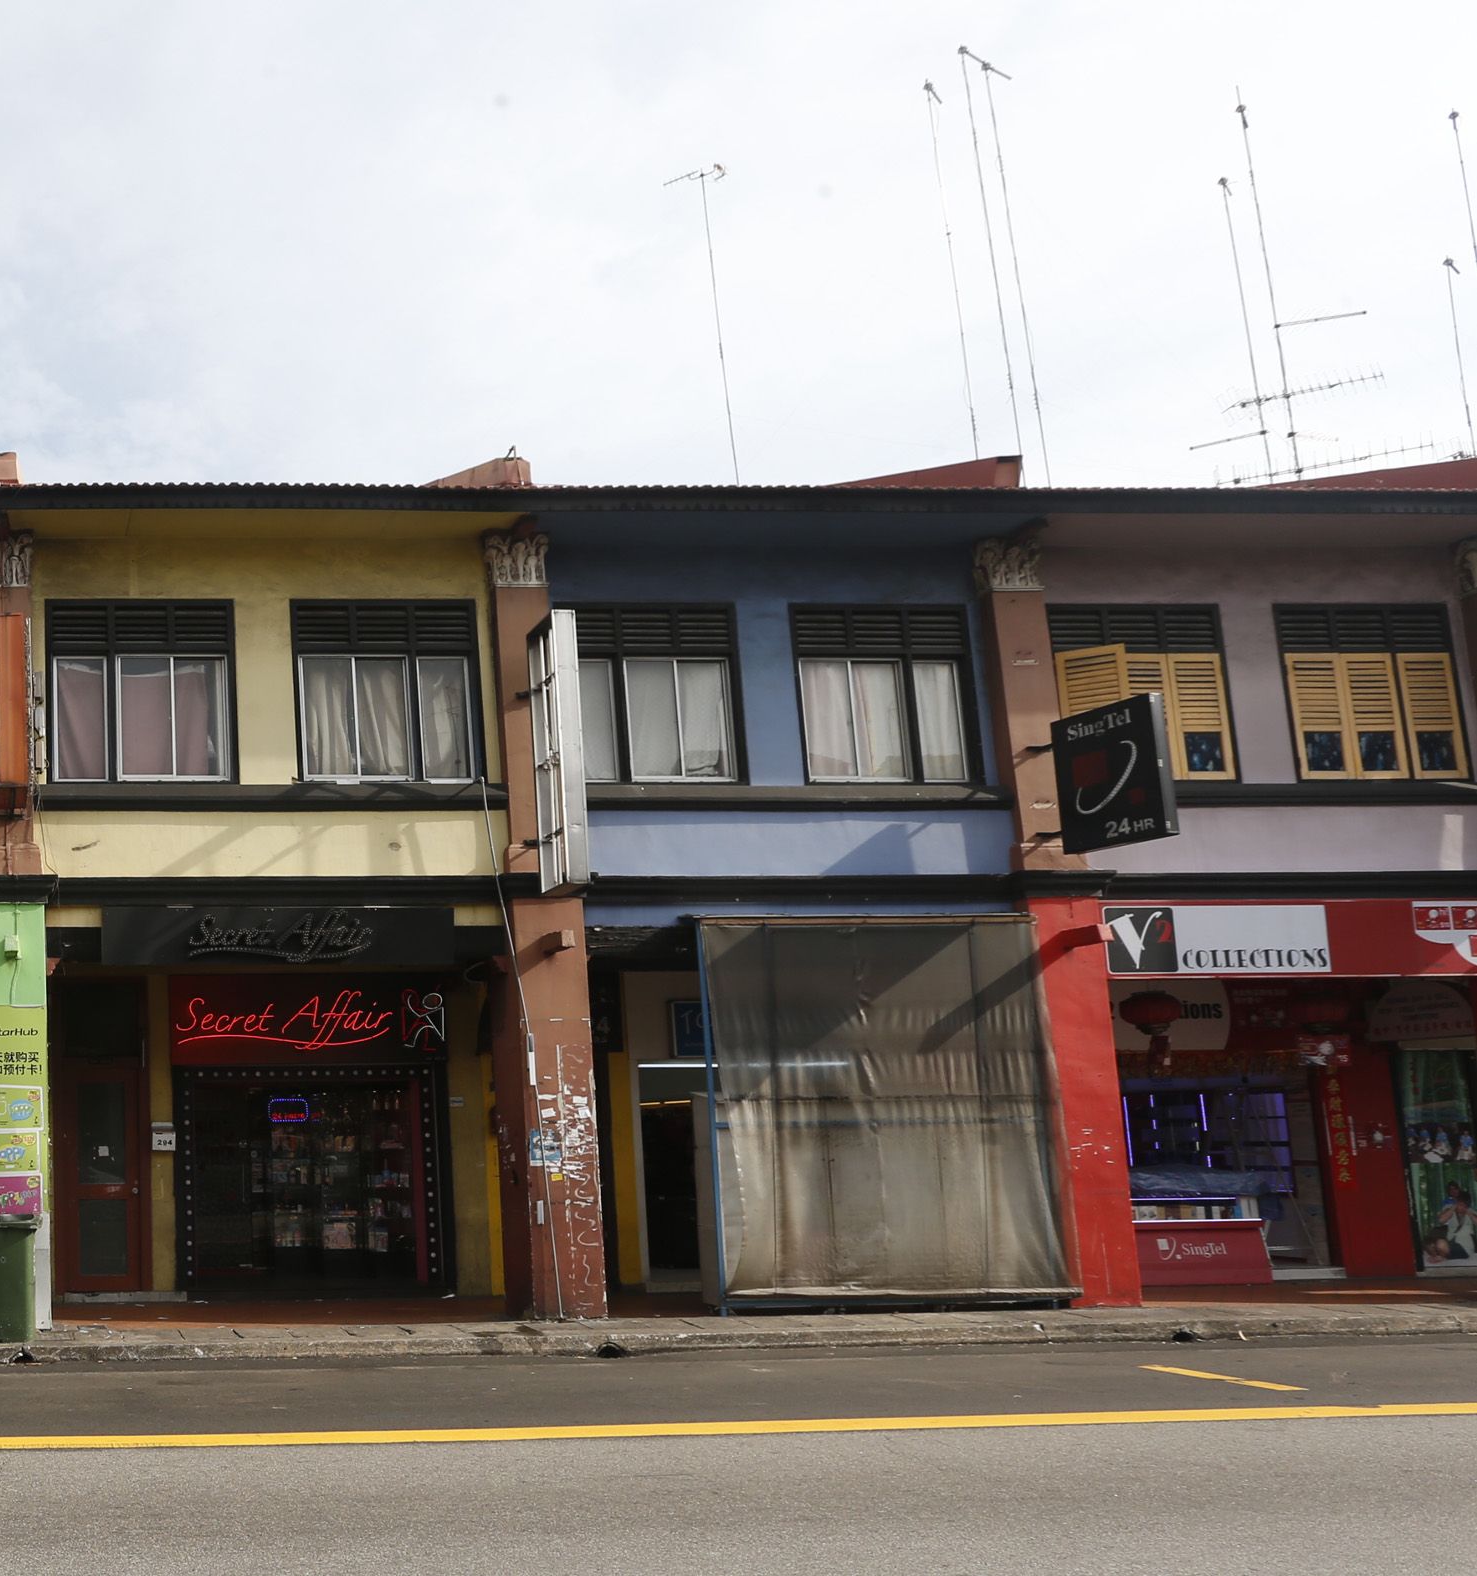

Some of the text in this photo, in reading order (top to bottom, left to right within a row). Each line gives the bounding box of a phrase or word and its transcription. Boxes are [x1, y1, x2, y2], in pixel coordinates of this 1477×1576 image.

[1067, 708, 1132, 741] SingTel
[1105, 818, 1155, 838] 24 HR
[188, 909, 374, 963] Secret Affair
[1182, 948, 1328, 969] COLLECTIONS
[175, 989, 394, 1050] Secret Affair
[1181, 1242, 1228, 1258] SingTel
